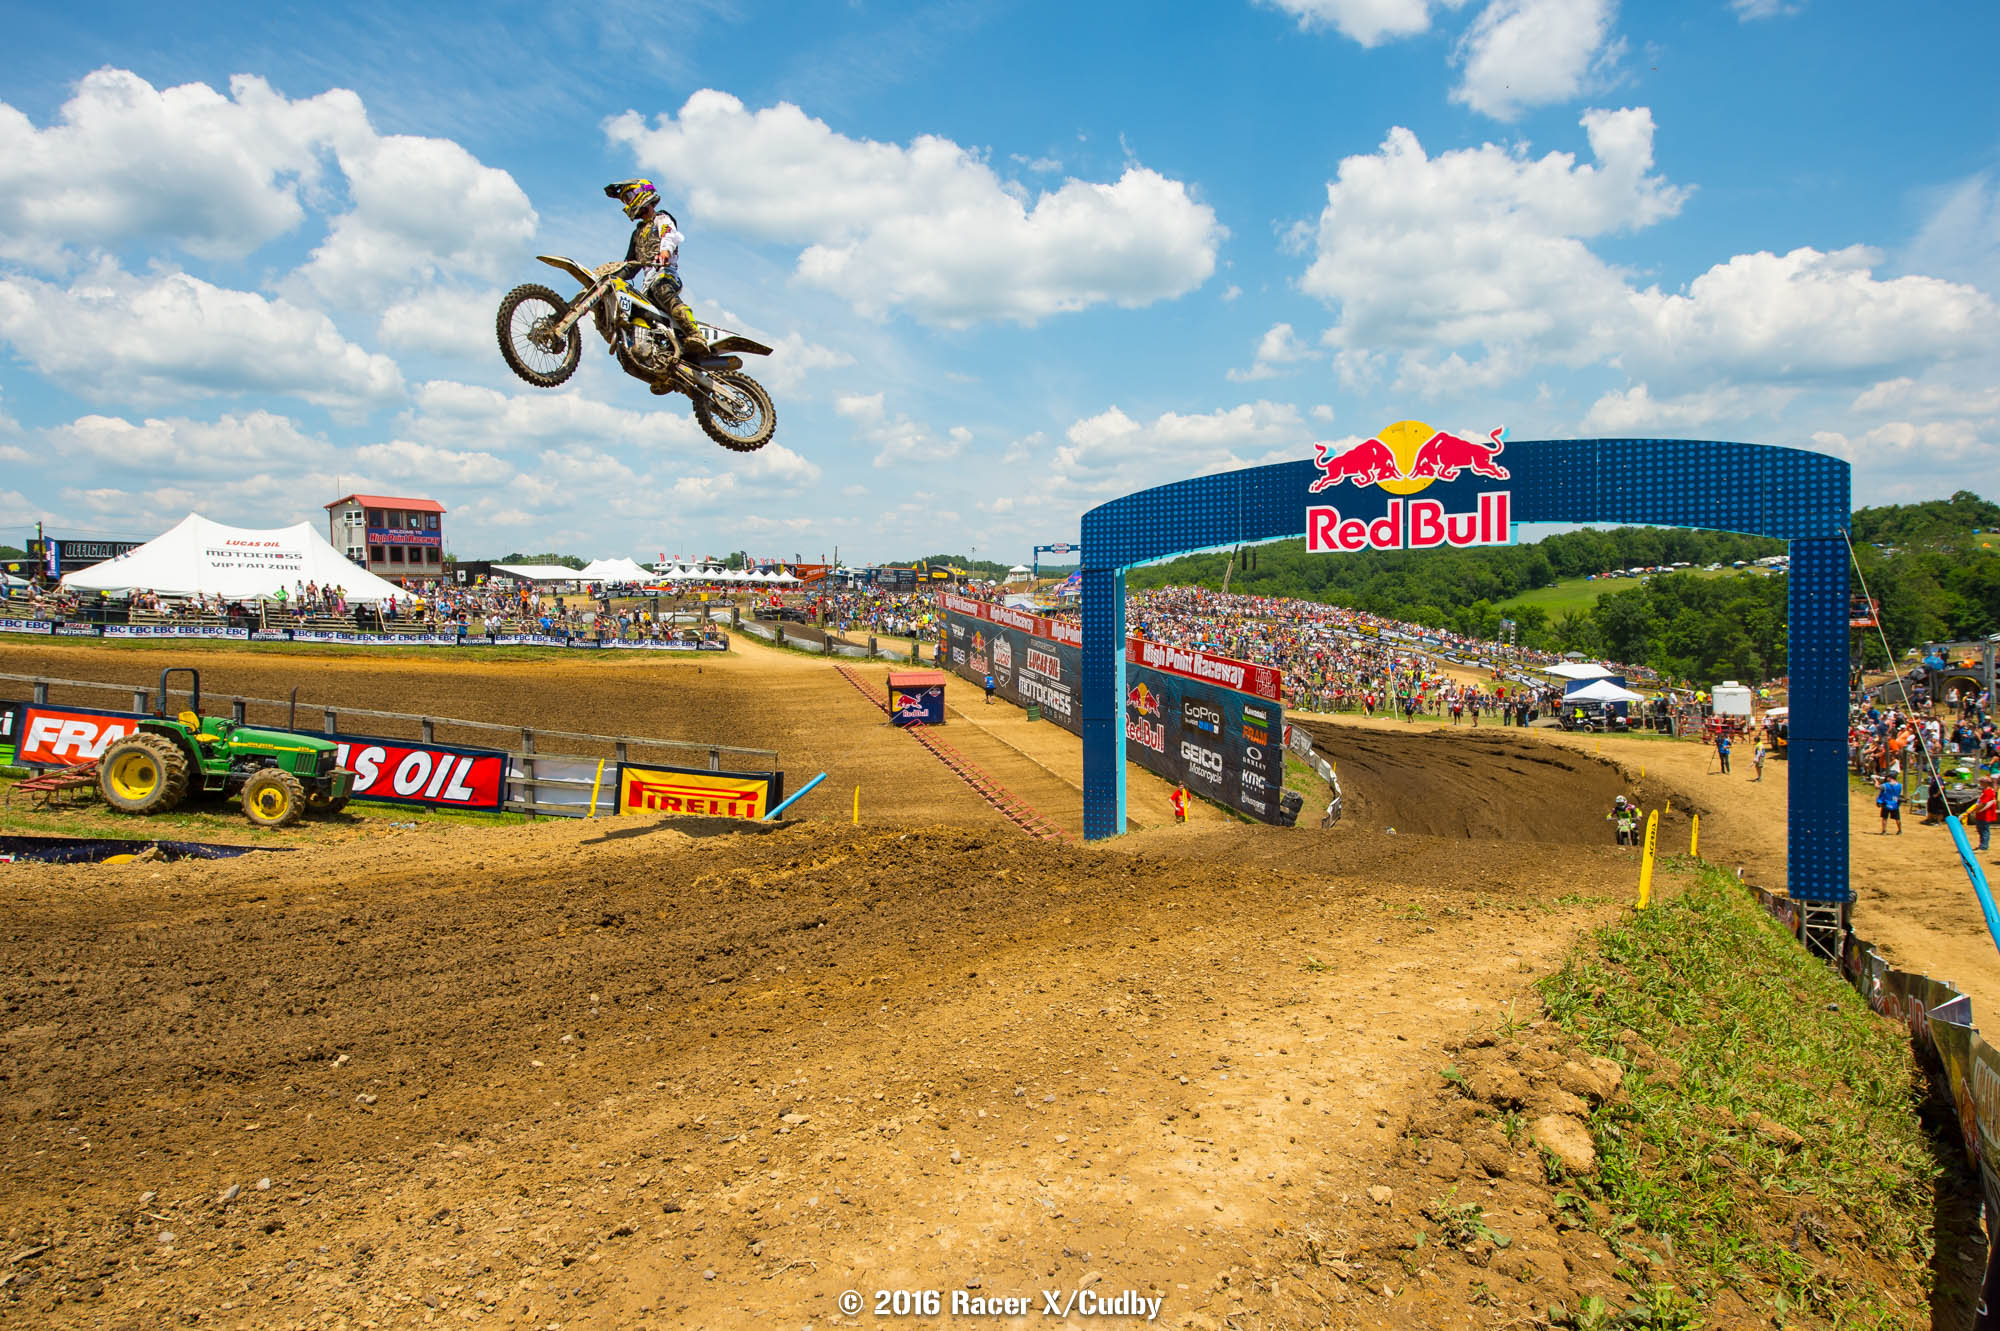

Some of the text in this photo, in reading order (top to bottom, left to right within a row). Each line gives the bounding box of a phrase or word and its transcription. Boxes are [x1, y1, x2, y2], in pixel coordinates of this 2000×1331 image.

[1306, 491, 1510, 553] Red Bull
[369, 533, 440, 544] High Point Raceway
[65, 542, 114, 558] OFFICIAL
[206, 550, 303, 560] MOTOCROSS
[25, 621, 50, 630] EBC
[130, 626, 152, 634] EBC
[154, 626, 176, 634] EBC
[178, 626, 200, 634] EBC
[202, 626, 224, 634] EBC
[226, 628, 247, 636] EBC
[294, 629, 312, 637] EBC
[315, 630, 334, 638] EBC
[336, 632, 354, 640] EBC
[1052, 621, 1065, 641] High
[1029, 650, 1048, 674] LUCAS
[1048, 657, 1059, 678] OIL
[1143, 643, 1165, 667] High
[1166, 647, 1194, 672] Point
[1194, 654, 1245, 689] Raceway
[1256, 668, 1272, 686] High
[1018, 676, 1072, 716] MOTOCROSS
[1256, 681, 1276, 698] Point
[1184, 702, 1220, 724] GoPro
[1244, 705, 1267, 720] Kawasaki
[24, 717, 141, 759] FRA
[1126, 712, 1164, 754] Red Bull
[1242, 725, 1268, 746] FRAM
[1180, 741, 1222, 772] GEICO
[1242, 756, 1266, 770] OAKLEY
[393, 751, 474, 801] OIL
[1189, 762, 1222, 784] Motorcycle
[1242, 768, 1266, 790] KMC
[628, 780, 759, 818] PIRELLI
